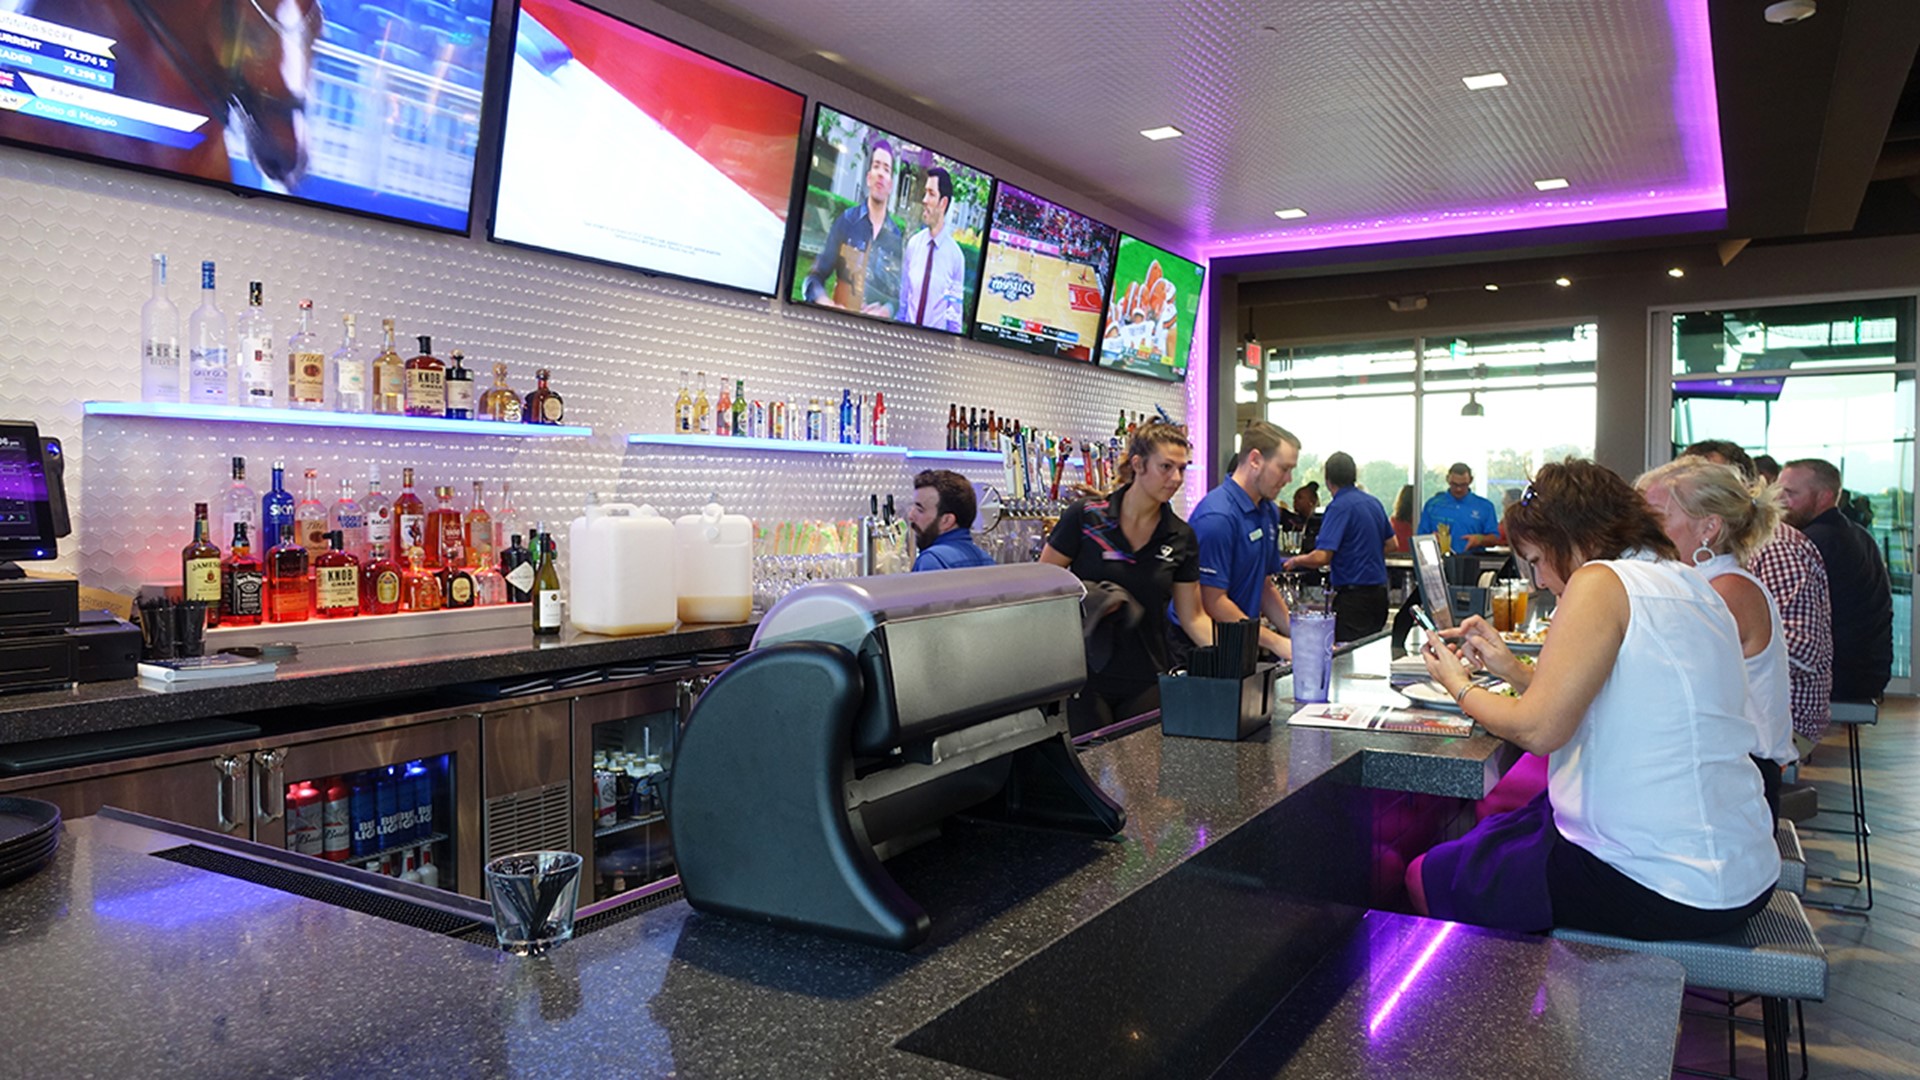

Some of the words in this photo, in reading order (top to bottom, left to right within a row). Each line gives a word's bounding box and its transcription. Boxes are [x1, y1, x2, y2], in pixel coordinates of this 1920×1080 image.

[35, 101, 65, 115] Dono
[79, 111, 117, 127] Maggio
[418, 372, 440, 384] KNOB
[328, 569, 353, 582] KNOB
